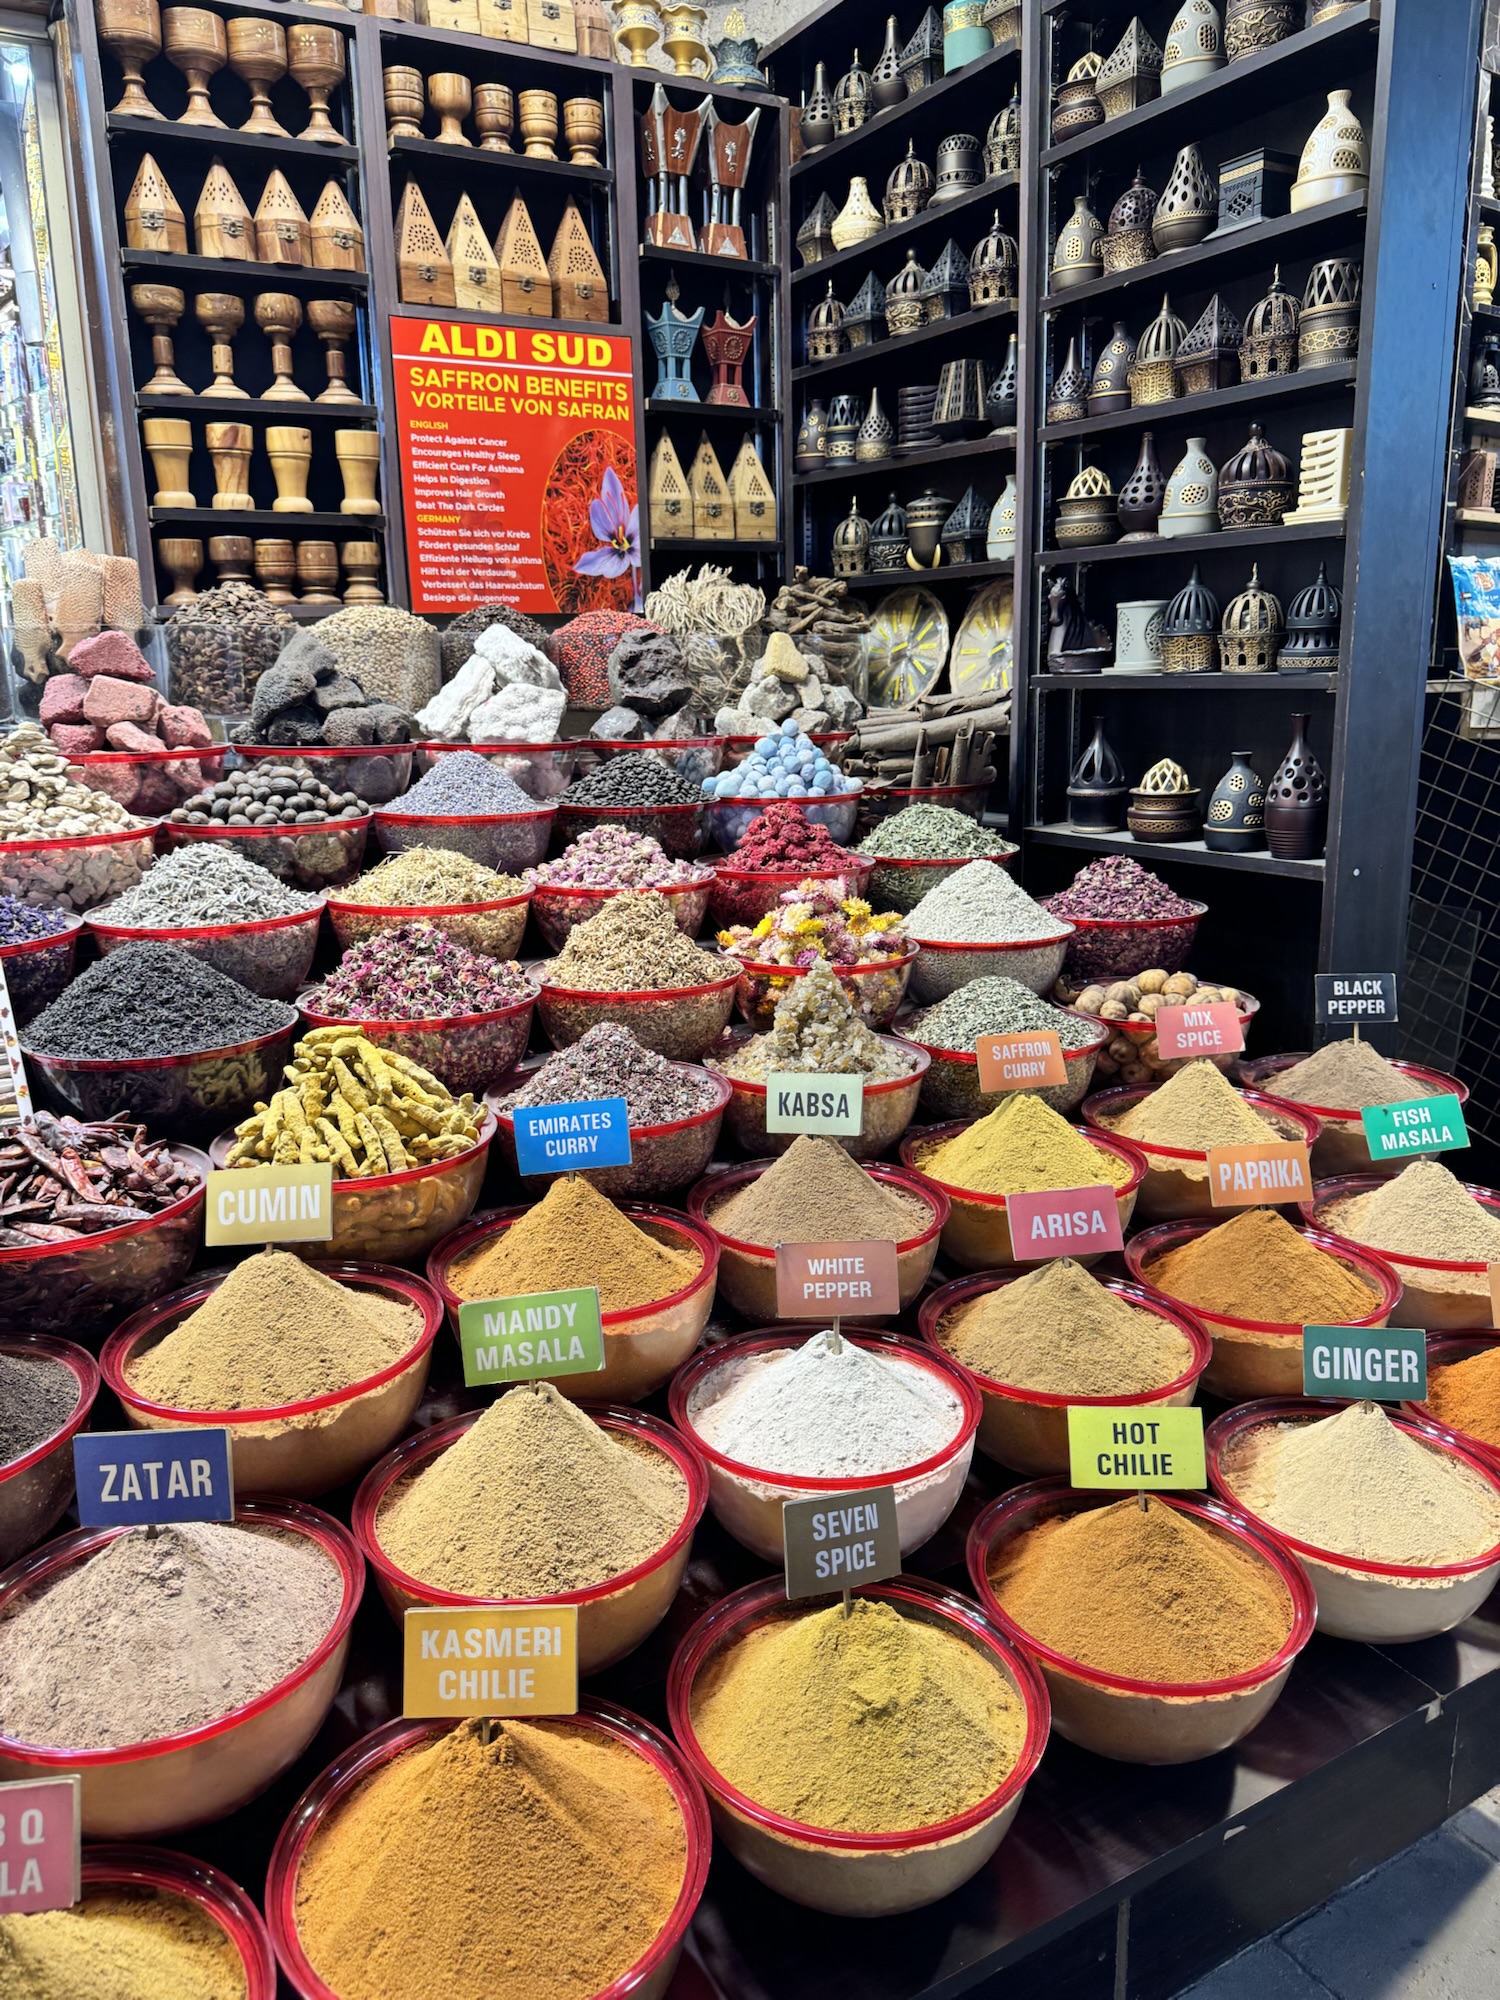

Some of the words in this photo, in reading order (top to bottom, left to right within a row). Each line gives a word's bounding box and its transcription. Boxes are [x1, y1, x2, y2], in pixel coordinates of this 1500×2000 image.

[420, 324, 516, 360] ALDI
[531, 334, 612, 367] SUD
[410, 368, 519, 393] SAFFRON
[526, 378, 627, 401] BENEFITS
[411, 392, 506, 413] VORTEILE
[511, 398, 552, 415] VON
[558, 401, 629, 421] SAFRAN
[410, 420, 448, 430] ENGLISH
[411, 434, 442, 443] Protect
[445, 436, 476, 445] Against
[478, 438, 507, 446] Cancer
[412, 448, 462, 458] Encourages
[464, 450, 496, 460] Healthy
[498, 452, 520, 462] Sleep
[413, 461, 448, 470] Efficient
[450, 462, 470, 471] Cure
[472, 464, 486, 472] For
[488, 465, 524, 474] Asthama
[414, 474, 438, 484] Helps
[450, 476, 490, 486] Digestion
[414, 488, 454, 498] Improves
[456, 490, 473, 498] Hair
[475, 490, 504, 499] Growth
[416, 501, 436, 509] Beat
[438, 502, 453, 510] The
[456, 503, 475, 511] Dark
[477, 504, 504, 512] Circles
[417, 515, 460, 523] GERMANY
[418, 528, 457, 536] Schützen
[473, 529, 490, 537] sich
[418, 541, 451, 549] Fördert
[453, 543, 493, 551] gesunden
[495, 543, 520, 551] Schlaf
[420, 554, 460, 563] Effiziente
[462, 555, 493, 564] Heilung
[512, 556, 542, 564] Asthma
[456, 568, 470, 576] der
[472, 568, 516, 578] Verdauung
[423, 594, 456, 602] Besiege
[458, 594, 471, 602] die
[473, 594, 520, 602] Augenringe
[1333, 980, 1383, 996] BLACK
[1327, 998, 1386, 1015] PEPPER
[1183, 1010, 1212, 1028] MIX
[1176, 1029, 1223, 1048] SPICE
[992, 1041, 1052, 1060] SAFFRON
[1003, 1060, 1046, 1080] CURRY
[778, 1092, 850, 1119] KABSA
[529, 1112, 612, 1137] EMIRATES
[1392, 1106, 1432, 1126] FISH
[545, 1135, 598, 1158] CURRY
[1380, 1126, 1453, 1151] MASALA
[1219, 1158, 1304, 1191] PAPRIKA
[217, 1184, 321, 1227] CUMIN
[1031, 1210, 1107, 1240] ARISA
[807, 1257, 865, 1276] WHITE
[803, 1281, 872, 1299] PEPPER
[483, 1303, 578, 1337] MANDY
[475, 1335, 585, 1372] MASALA
[1312, 1345, 1419, 1384] GINGER
[1113, 1422, 1160, 1445] HOT
[1097, 1453, 1173, 1476] CHILIE
[99, 1459, 213, 1503] ZATAR
[812, 1503, 879, 1542] SEVEN
[815, 1540, 876, 1578] SPICE
[421, 1626, 562, 1659] KASMERI
[438, 1668, 534, 1700] CHILIE
